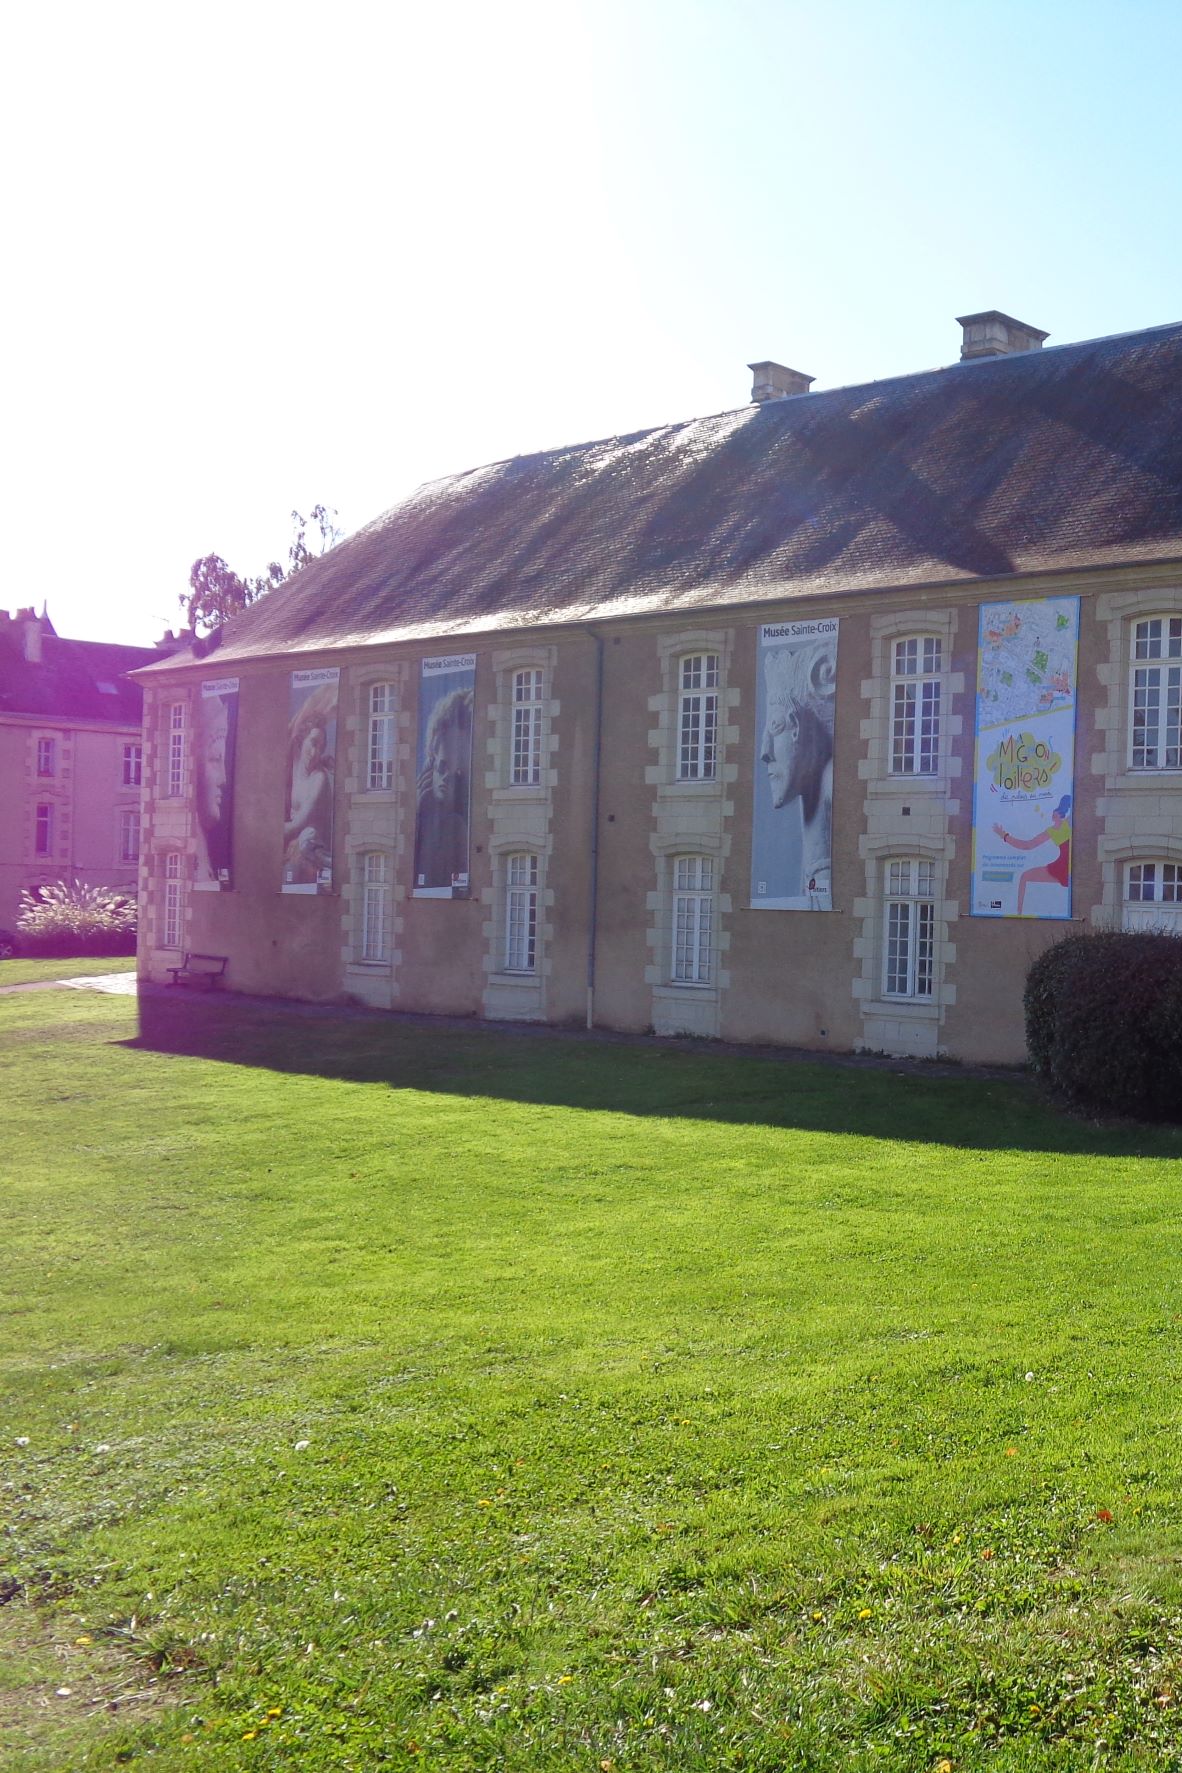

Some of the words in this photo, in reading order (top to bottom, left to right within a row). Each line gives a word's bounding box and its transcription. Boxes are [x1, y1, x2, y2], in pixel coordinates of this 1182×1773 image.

[763, 625, 790, 638] Musée
[791, 620, 837, 636] Sainte-Croix
[423, 661, 442, 670] Musée
[443, 656, 475, 668] Sainte-Croix
[294, 671, 310, 681] Musée
[310, 669, 338, 680] Sainte-Croix
